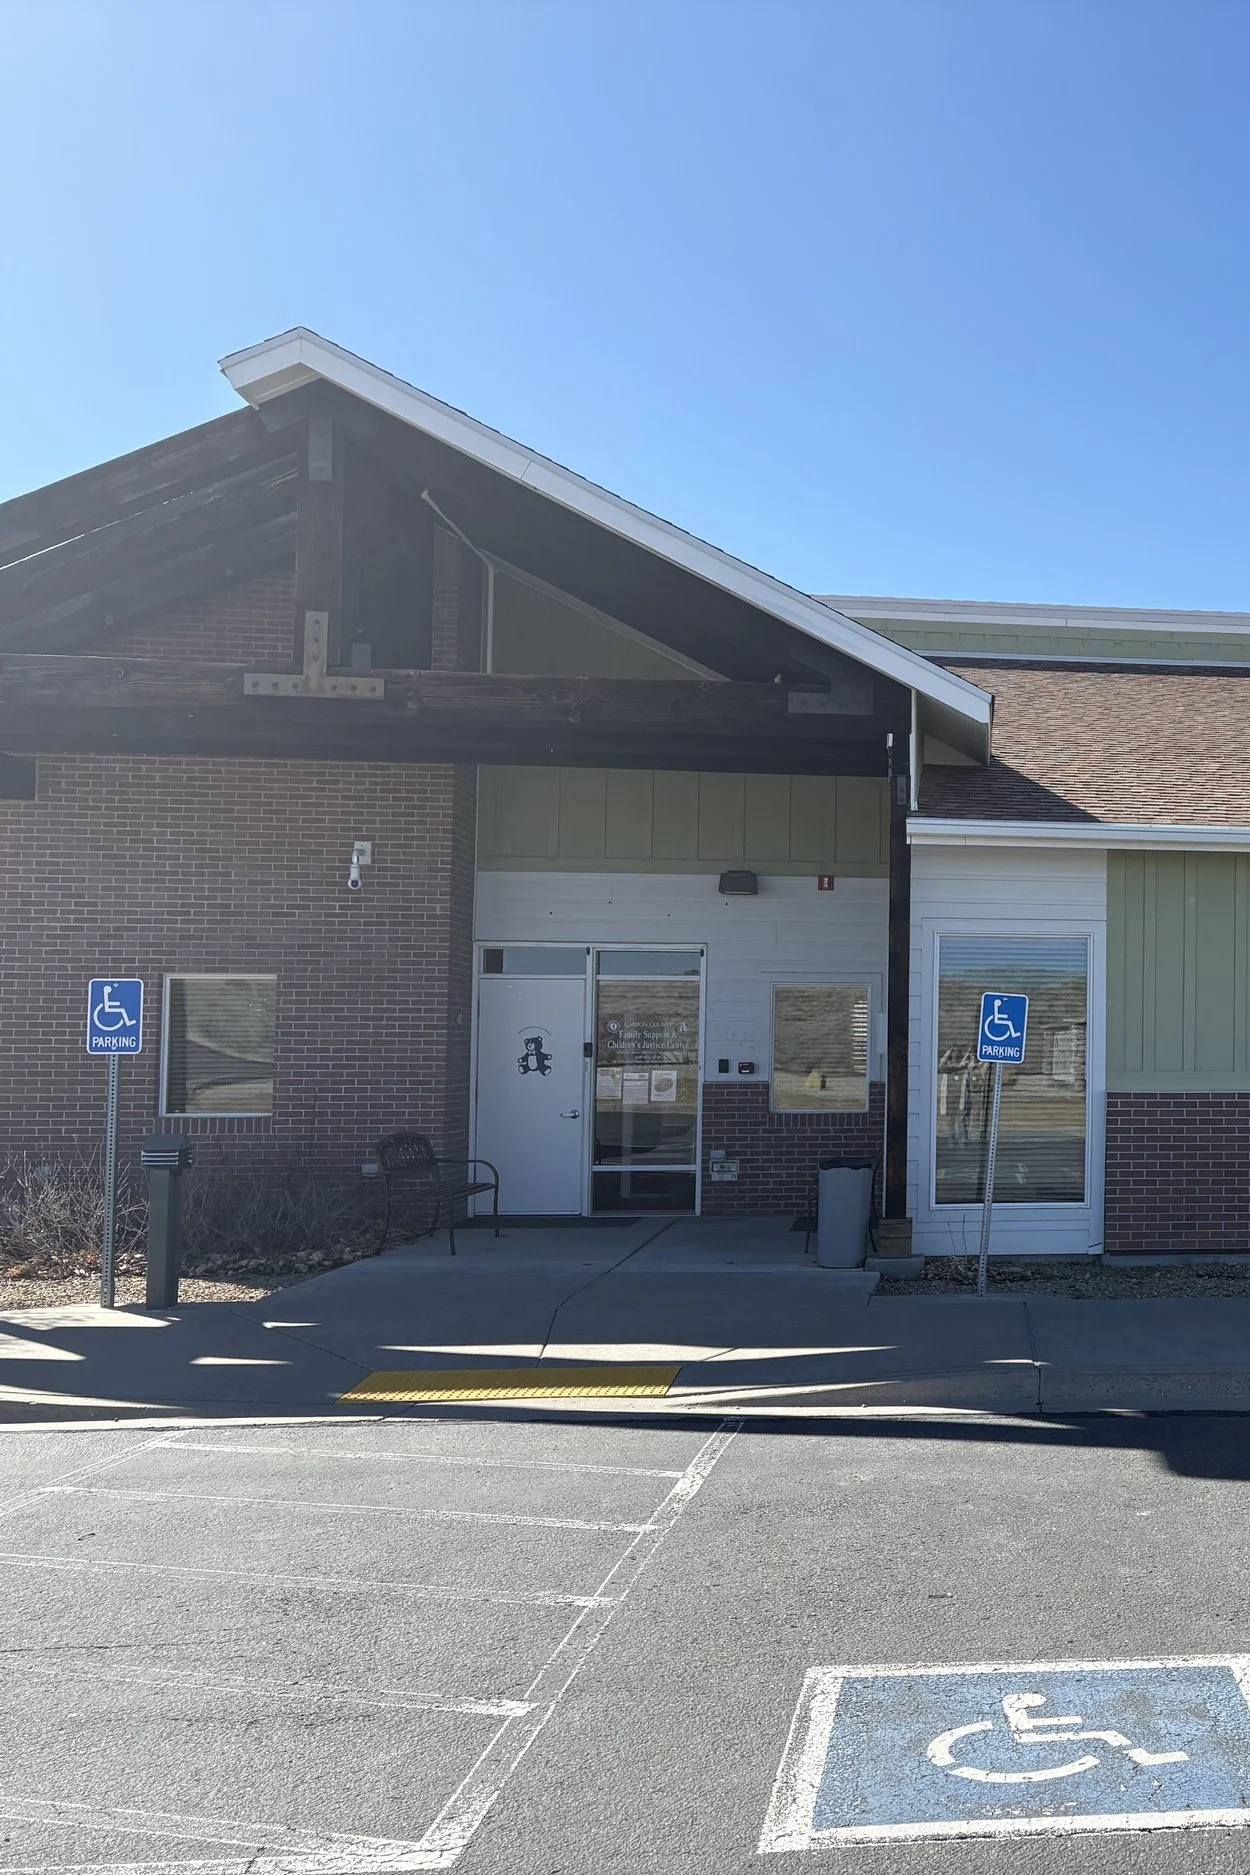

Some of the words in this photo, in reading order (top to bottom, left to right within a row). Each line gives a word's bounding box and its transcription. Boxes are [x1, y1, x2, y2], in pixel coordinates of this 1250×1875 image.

[619, 1030, 641, 1040] Family
[643, 1030, 670, 1040] Support
[671, 1031, 677, 1039] &
[92, 1036, 137, 1048] PARKING
[607, 1040, 641, 1049] Children's
[642, 1040, 665, 1049] Justice
[666, 1040, 689, 1049] Center
[982, 1044, 1021, 1058] PARKING
